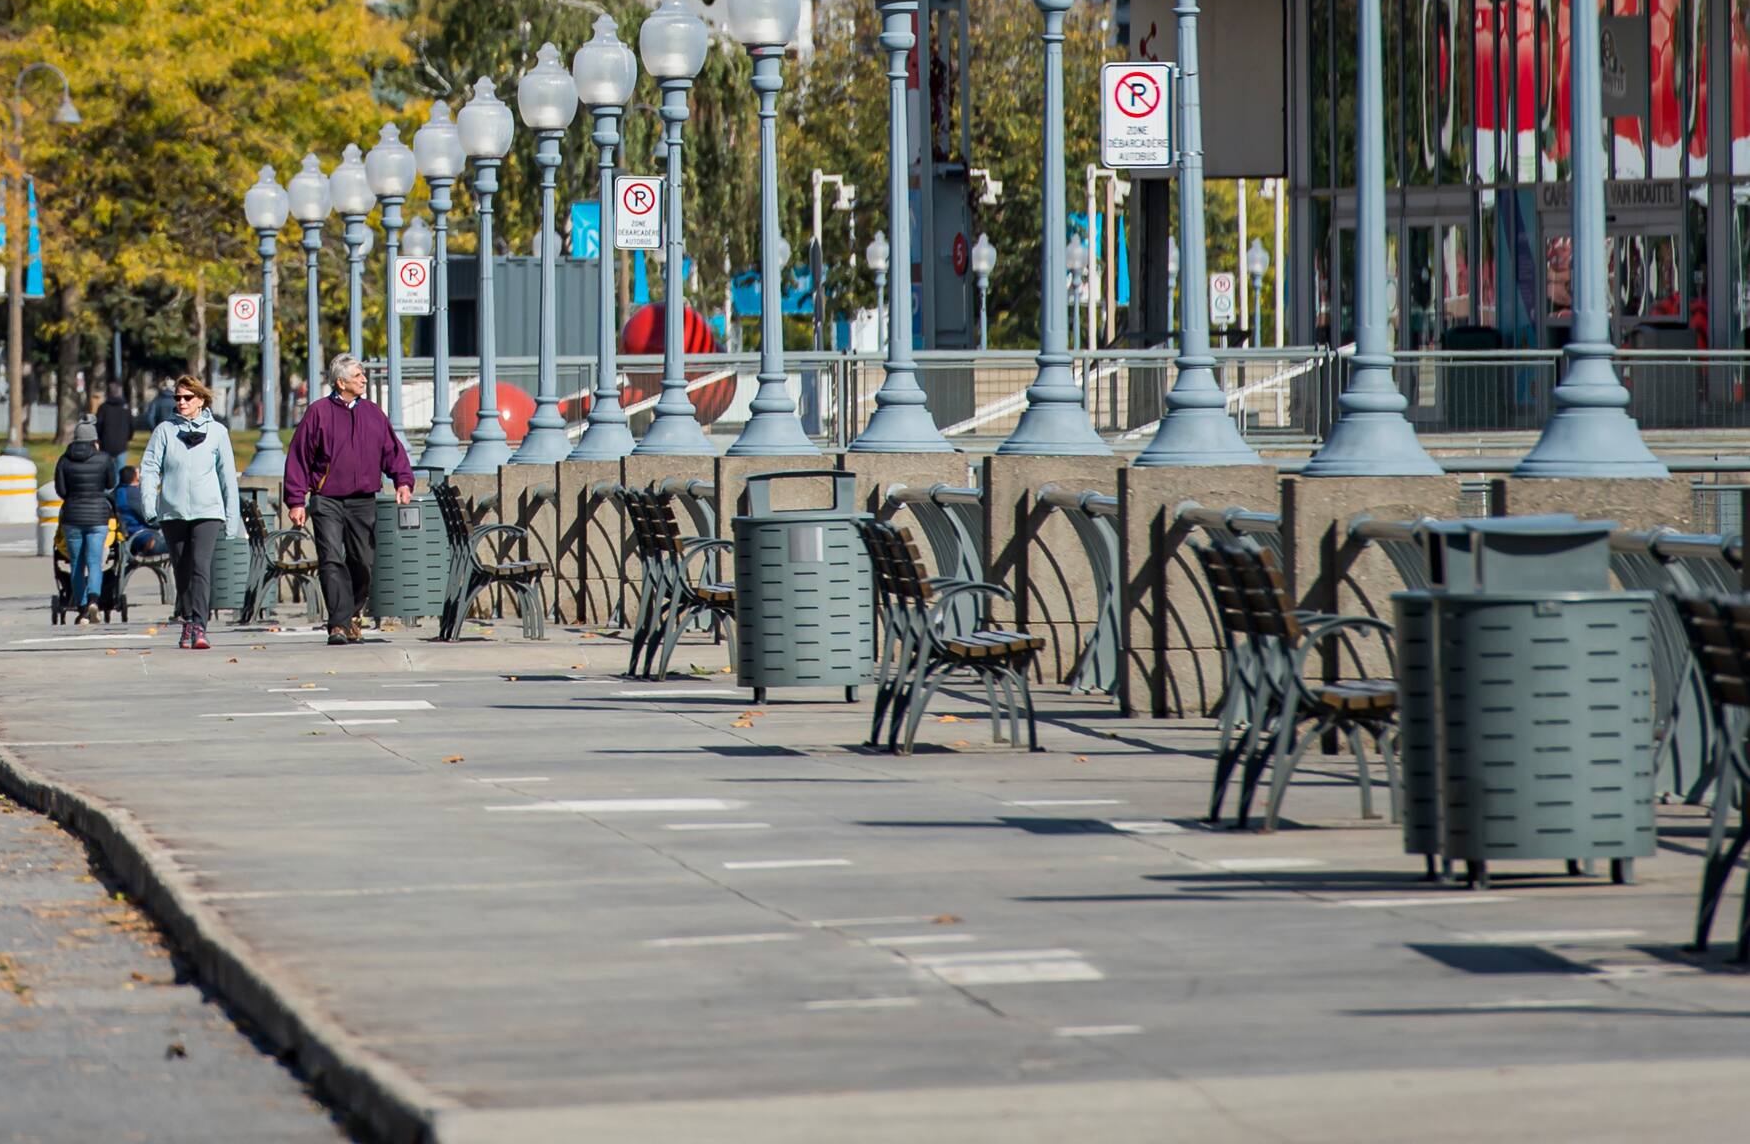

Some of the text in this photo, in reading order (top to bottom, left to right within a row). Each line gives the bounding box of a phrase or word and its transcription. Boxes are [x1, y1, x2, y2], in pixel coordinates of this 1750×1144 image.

[1126, 125, 1149, 135] ZONE
[1118, 151, 1158, 161] AUTOBUS
[1610, 184, 1631, 204] VAN
[1633, 182, 1674, 204] HOUTTE
